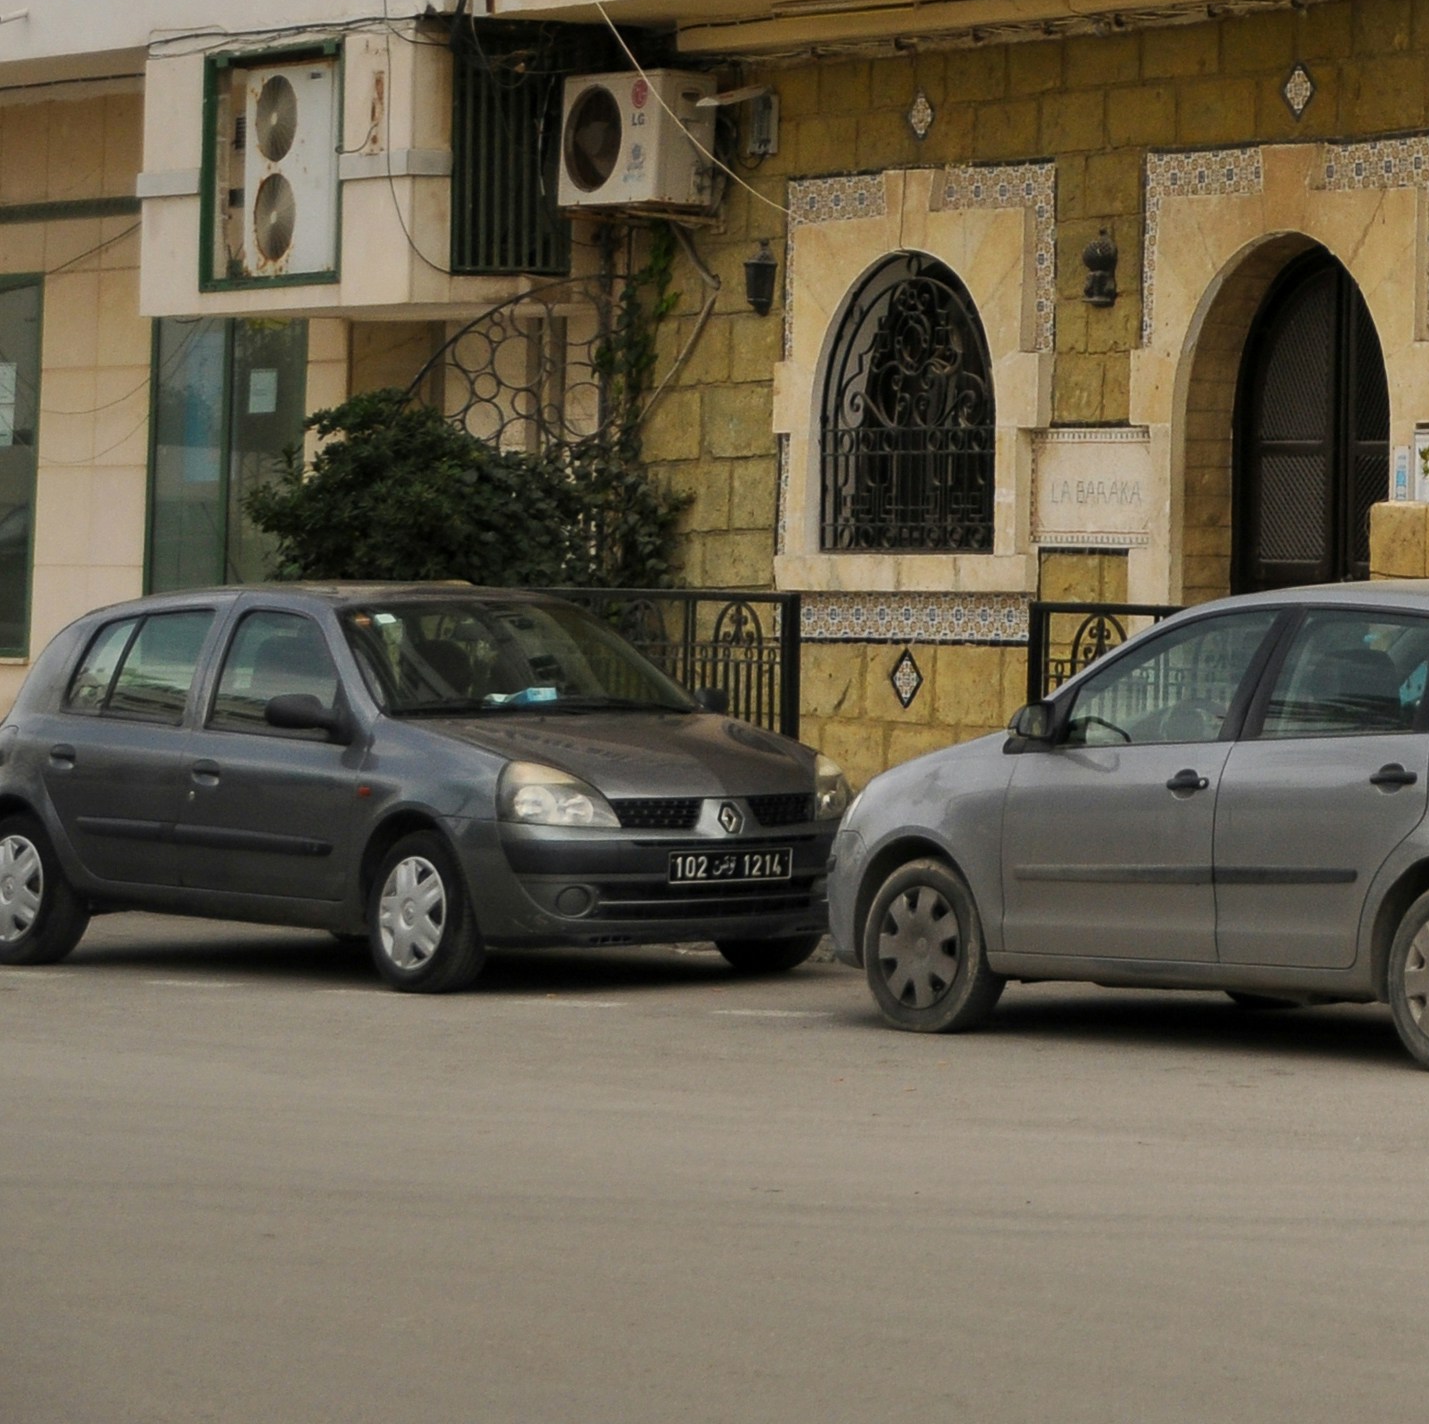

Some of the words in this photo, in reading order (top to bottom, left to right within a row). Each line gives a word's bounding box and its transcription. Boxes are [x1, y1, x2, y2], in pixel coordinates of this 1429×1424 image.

[631, 112, 645, 126] LG
[1051, 480, 1071, 504] LA
[1076, 480, 1142, 505] BARAKA
[676, 856, 708, 878] 102
[744, 854, 782, 875] 1214
